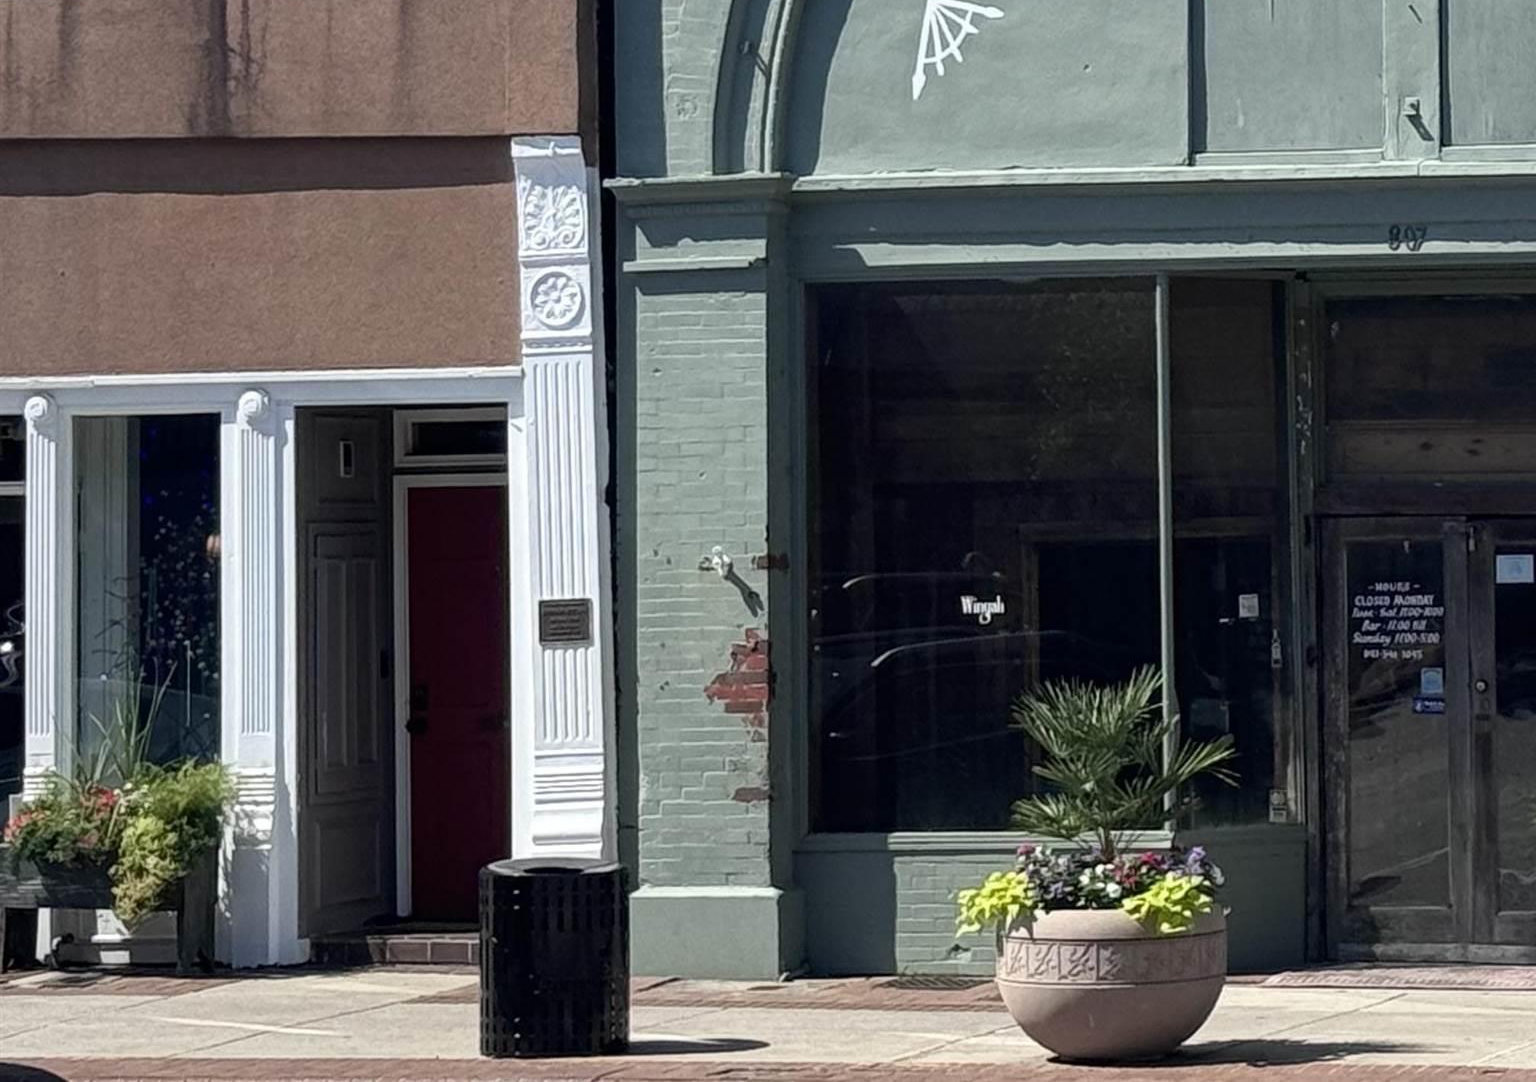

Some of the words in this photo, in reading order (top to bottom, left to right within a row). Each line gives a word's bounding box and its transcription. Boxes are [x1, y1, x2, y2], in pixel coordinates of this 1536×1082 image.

[1388, 224, 1427, 251] 807
[1354, 595, 1391, 607] CLOSED
[1393, 594, 1434, 606] MONDAY
[1353, 631, 1391, 647] Sunday
